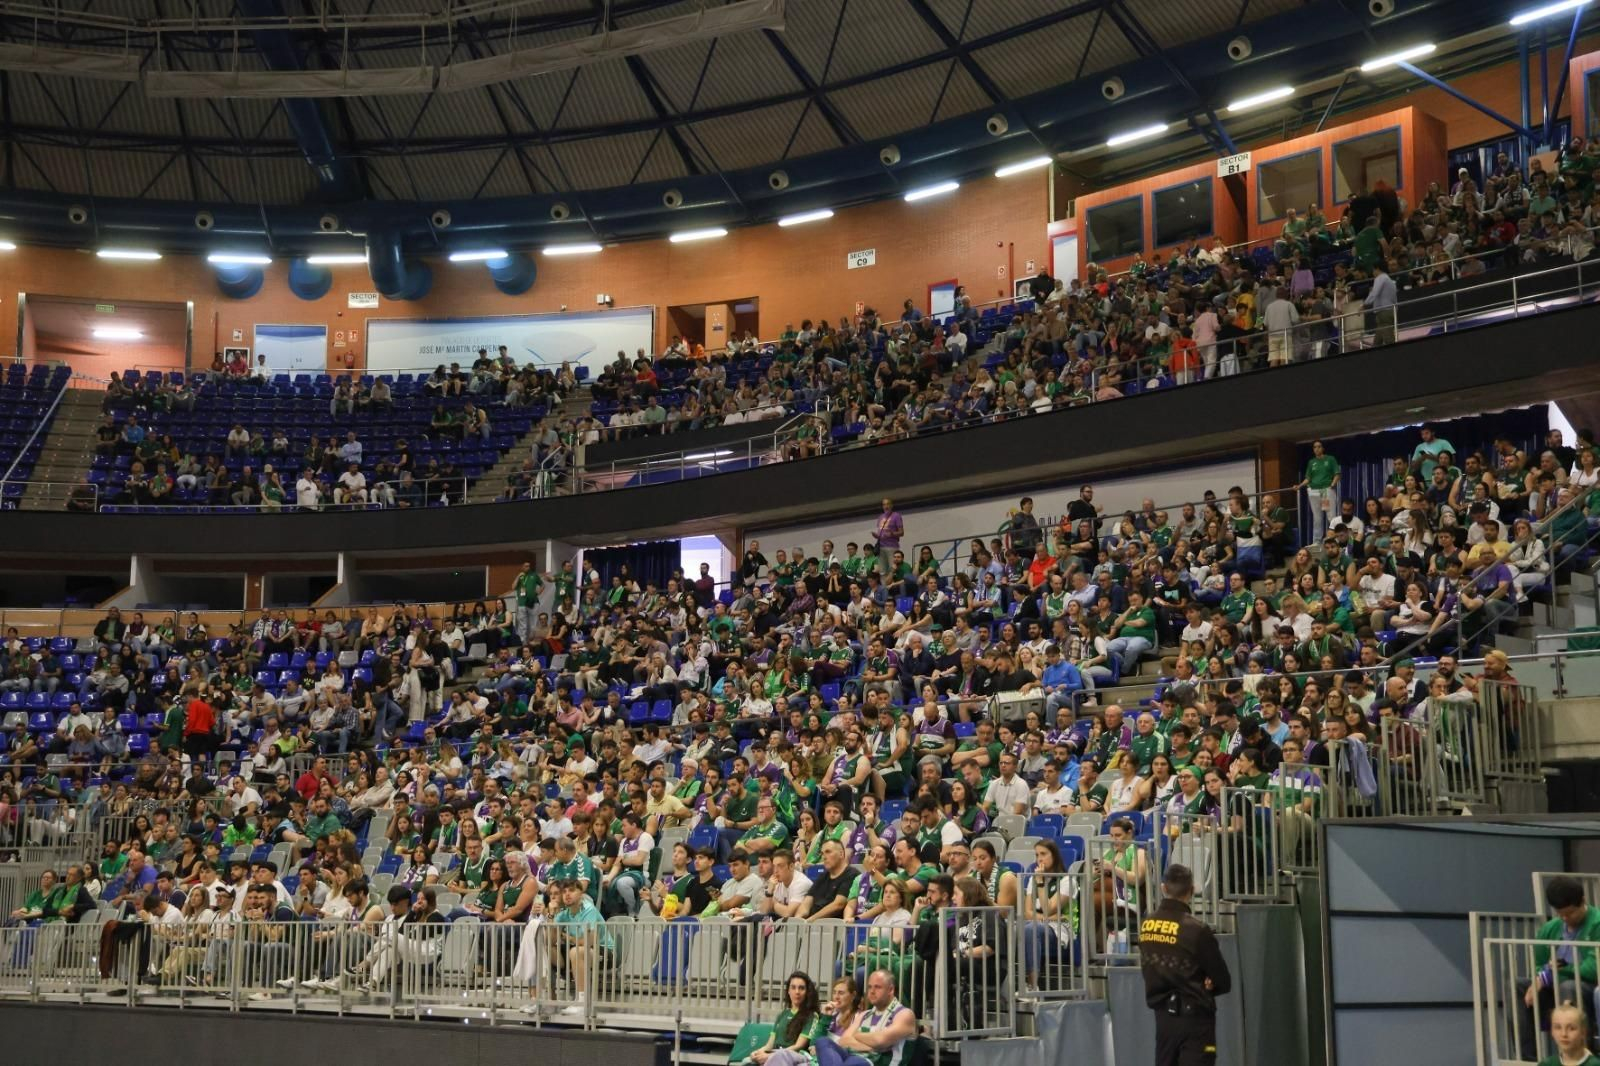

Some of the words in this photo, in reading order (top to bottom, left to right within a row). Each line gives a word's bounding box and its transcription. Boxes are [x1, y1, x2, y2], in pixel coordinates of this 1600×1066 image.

[1220, 153, 1249, 166] SECTOR
[1228, 164, 1240, 174] B1
[849, 250, 874, 259] SECTOR
[856, 258, 868, 266] C9
[419, 345, 434, 354] JOSÉ
[472, 343, 498, 353] CARPEN
[1141, 919, 1180, 936] COFER
